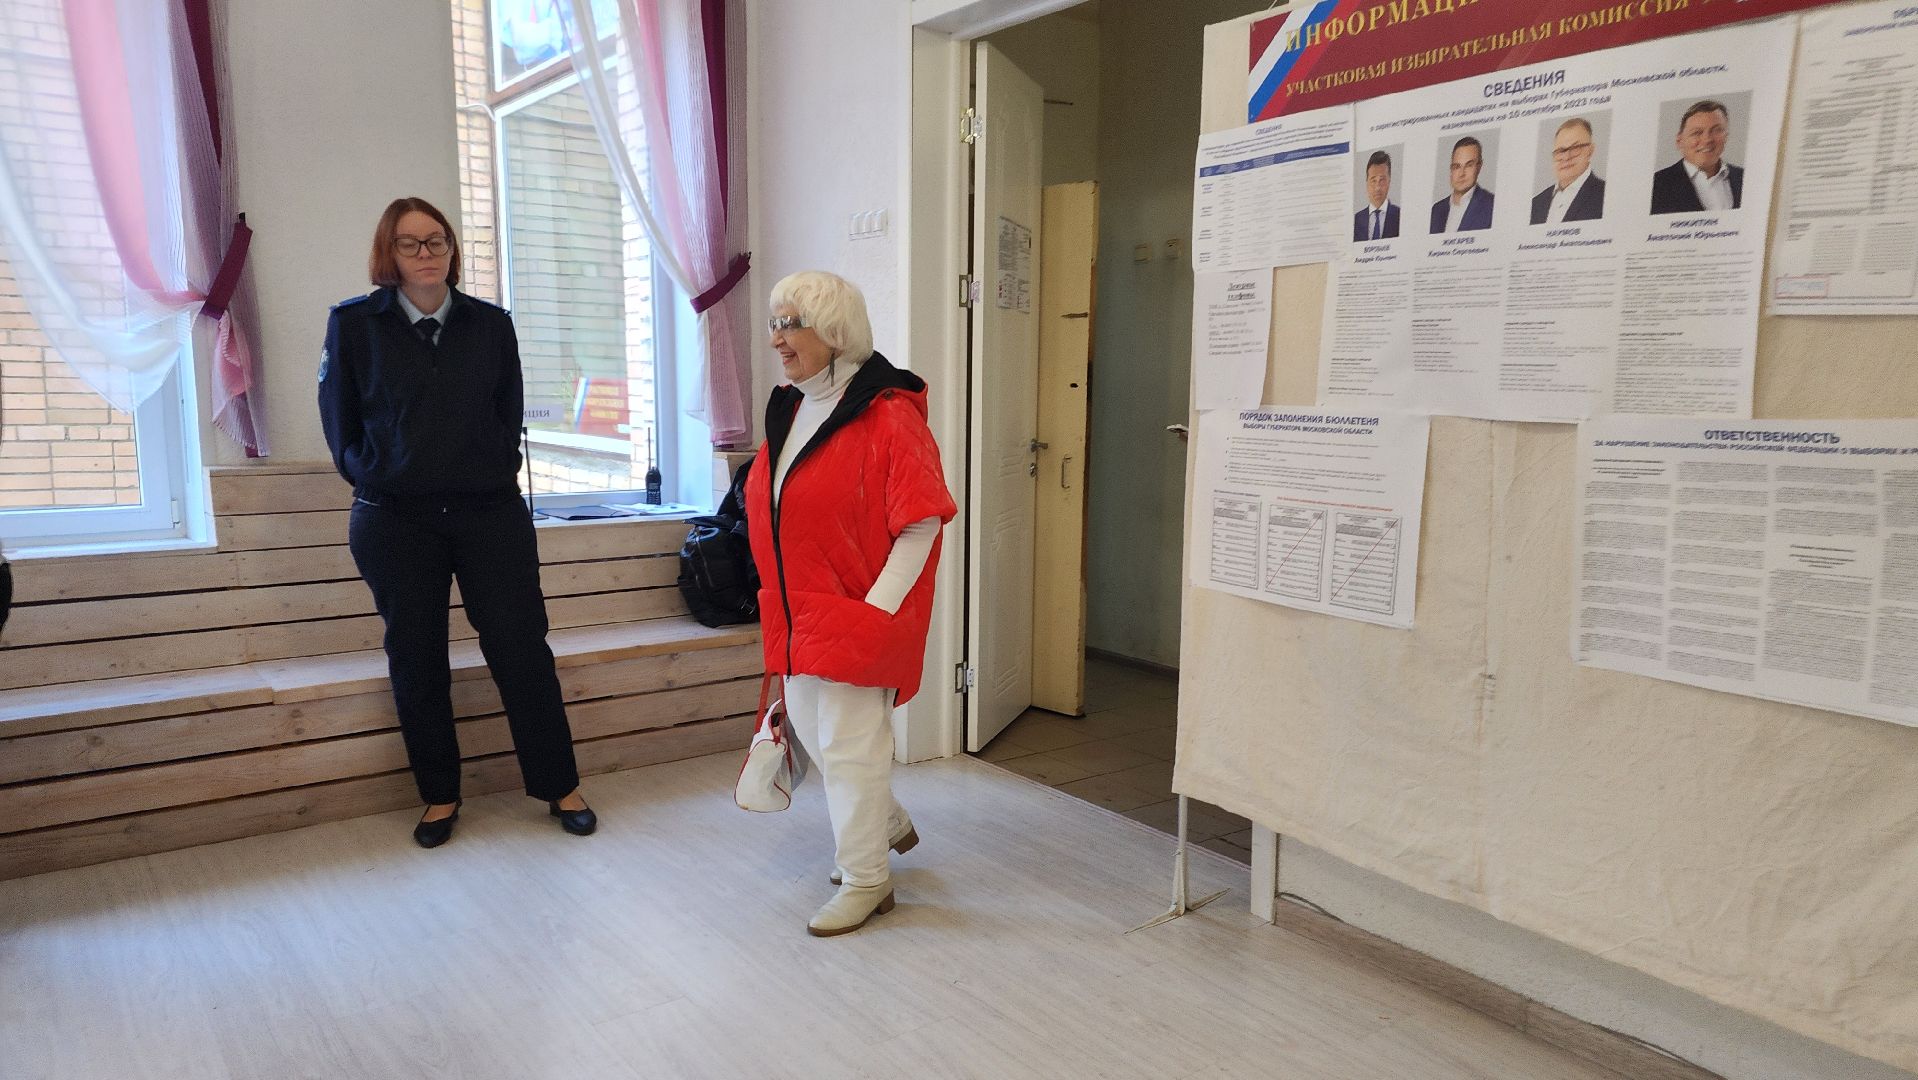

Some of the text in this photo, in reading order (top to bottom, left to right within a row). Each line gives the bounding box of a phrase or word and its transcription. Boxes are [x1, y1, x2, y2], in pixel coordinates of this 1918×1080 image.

[1285, 0, 1479, 53] ИНФОРМАЦ
[1286, 0, 1689, 97] УЧАСТКОВАЯ ИЗБИРАТЕЛЬНАЯ КОМИССИЯ
[1451, 103, 1497, 119] кандидатах
[1611, 70, 1676, 88] Московской
[1484, 70, 1566, 99] СВЕДЕНИЯ
[1239, 412, 1379, 427] ПОРЯДОК ЗАПОЛНЕНИЯ БЮЛЛЕТЕНЯ
[1704, 430, 1840, 444] ОТВЕТСТВЕННОСТЬ
